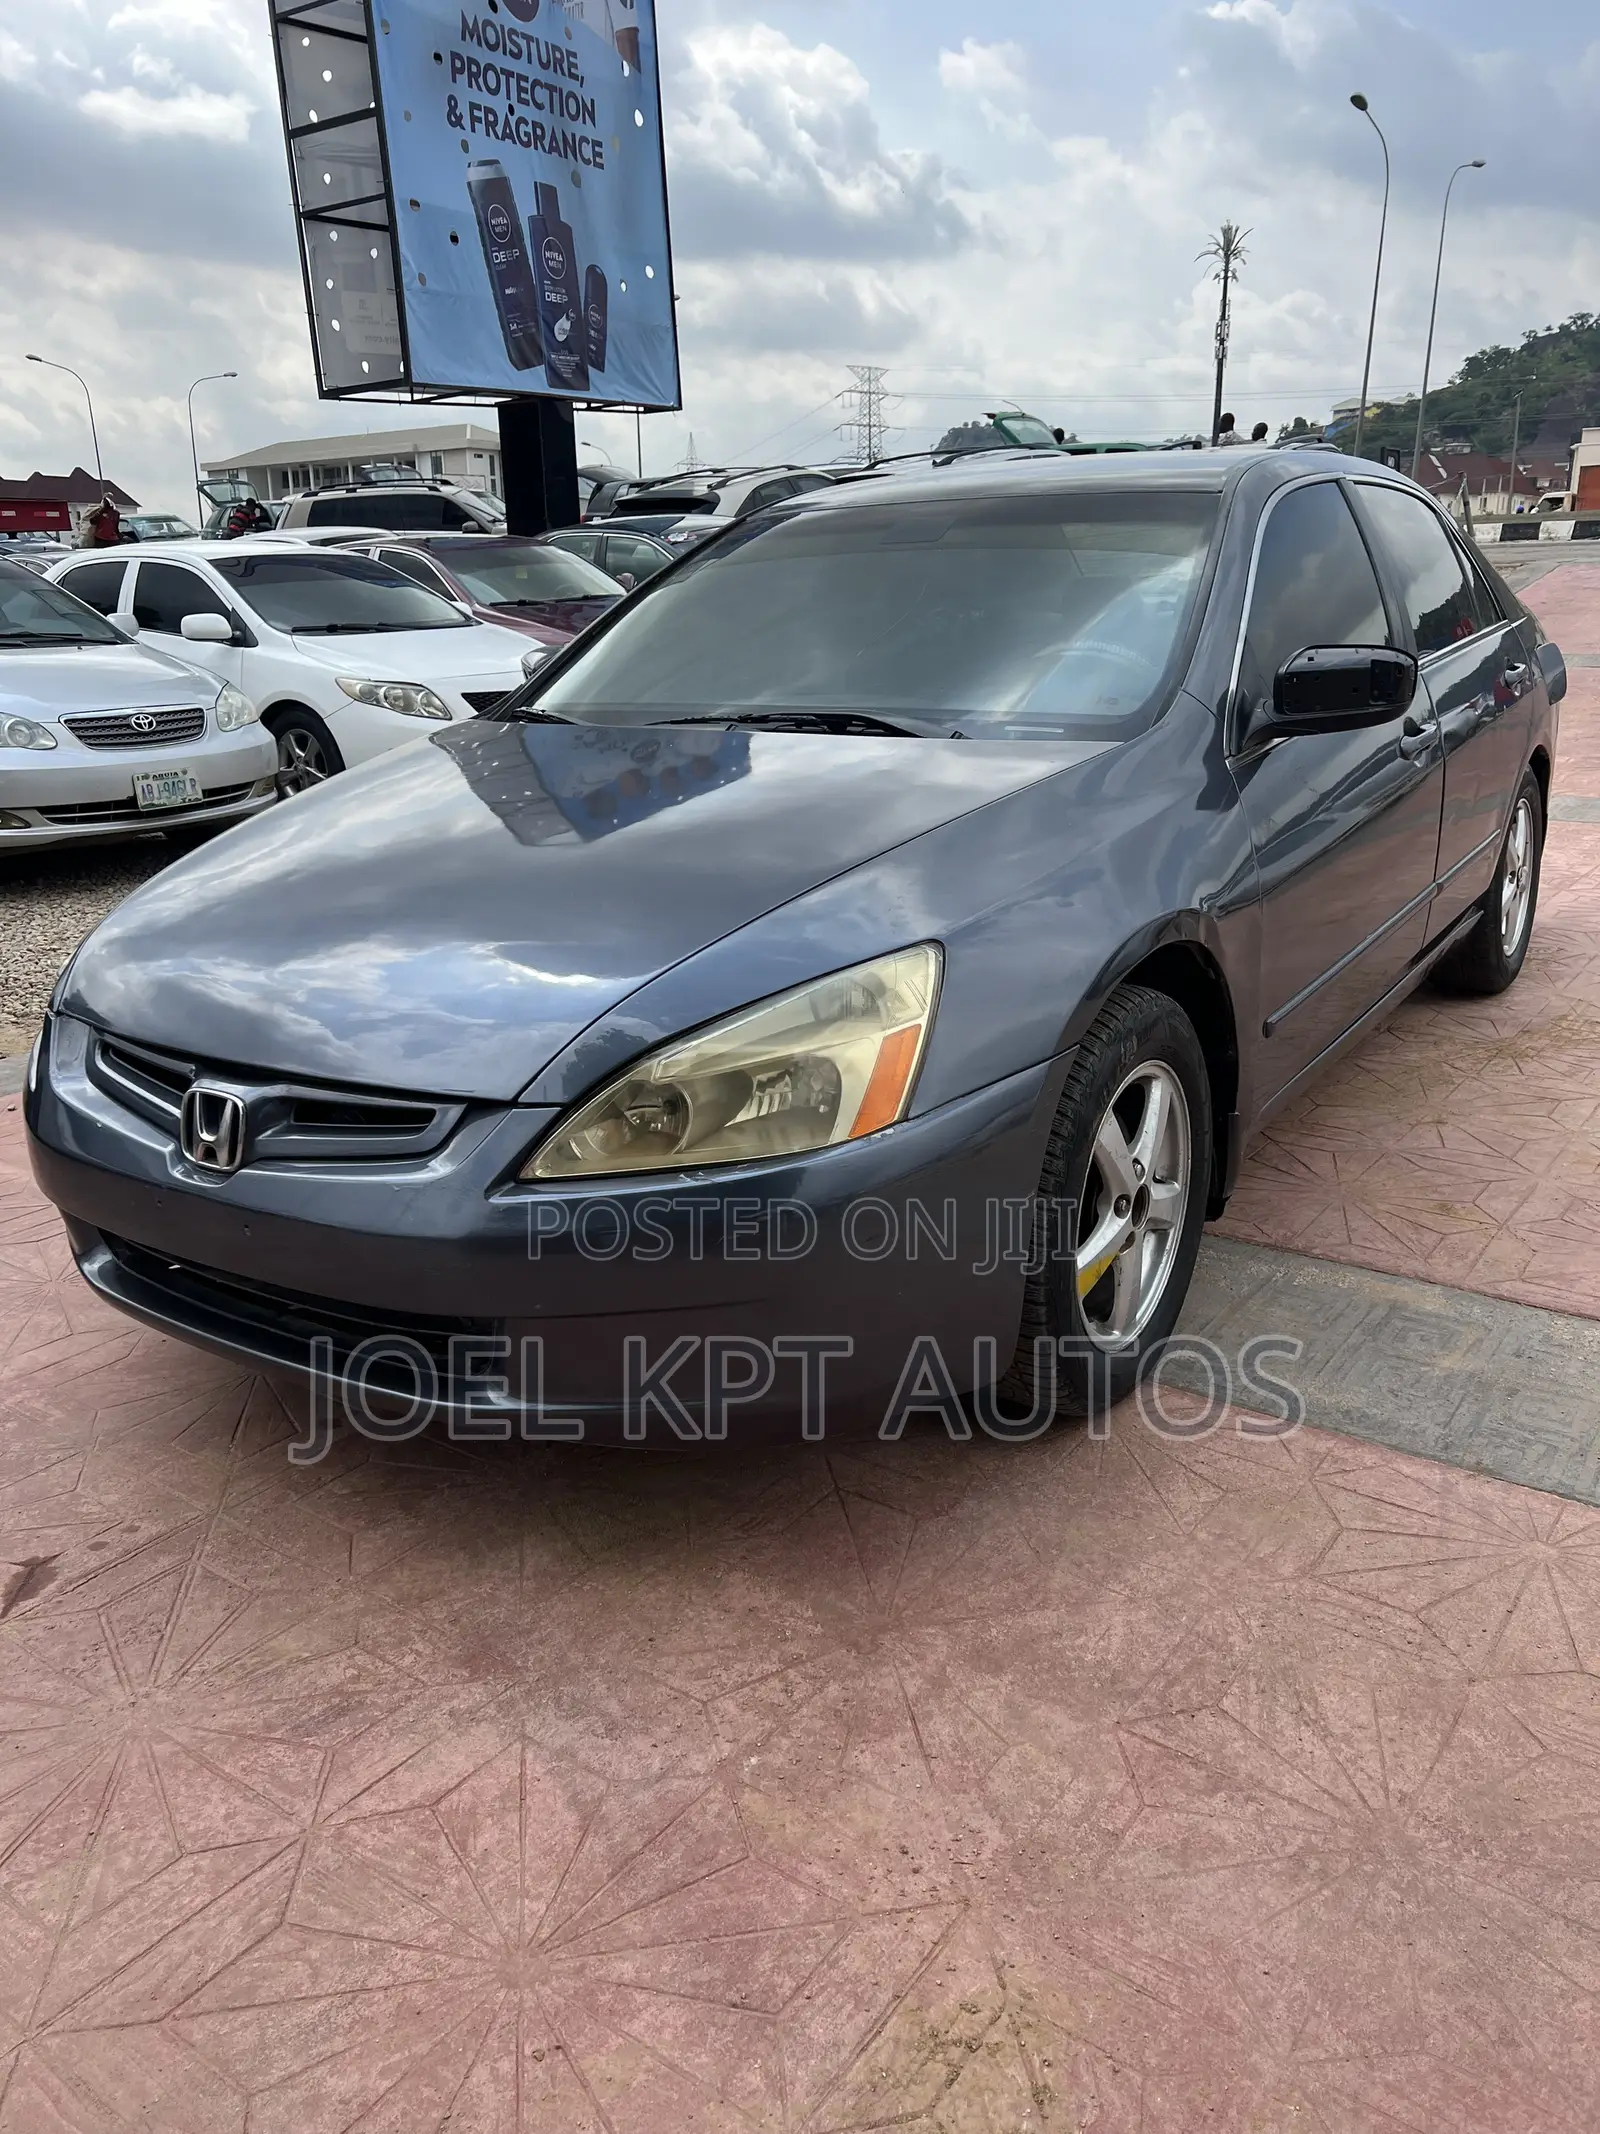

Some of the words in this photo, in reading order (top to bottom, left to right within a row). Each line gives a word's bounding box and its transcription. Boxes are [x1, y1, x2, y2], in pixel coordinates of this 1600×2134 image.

[461, 9, 585, 88] MOISTURE,
[450, 50, 597, 129] PROTECTION
[446, 94, 466, 131] &
[468, 101, 605, 170] FRAGRANCE
[491, 216, 507, 226] NIVEA
[492, 248, 520, 264] DEEP
[545, 250, 564, 262] NIVEA
[548, 260, 562, 269] MEN
[544, 291, 569, 304] DEEP
